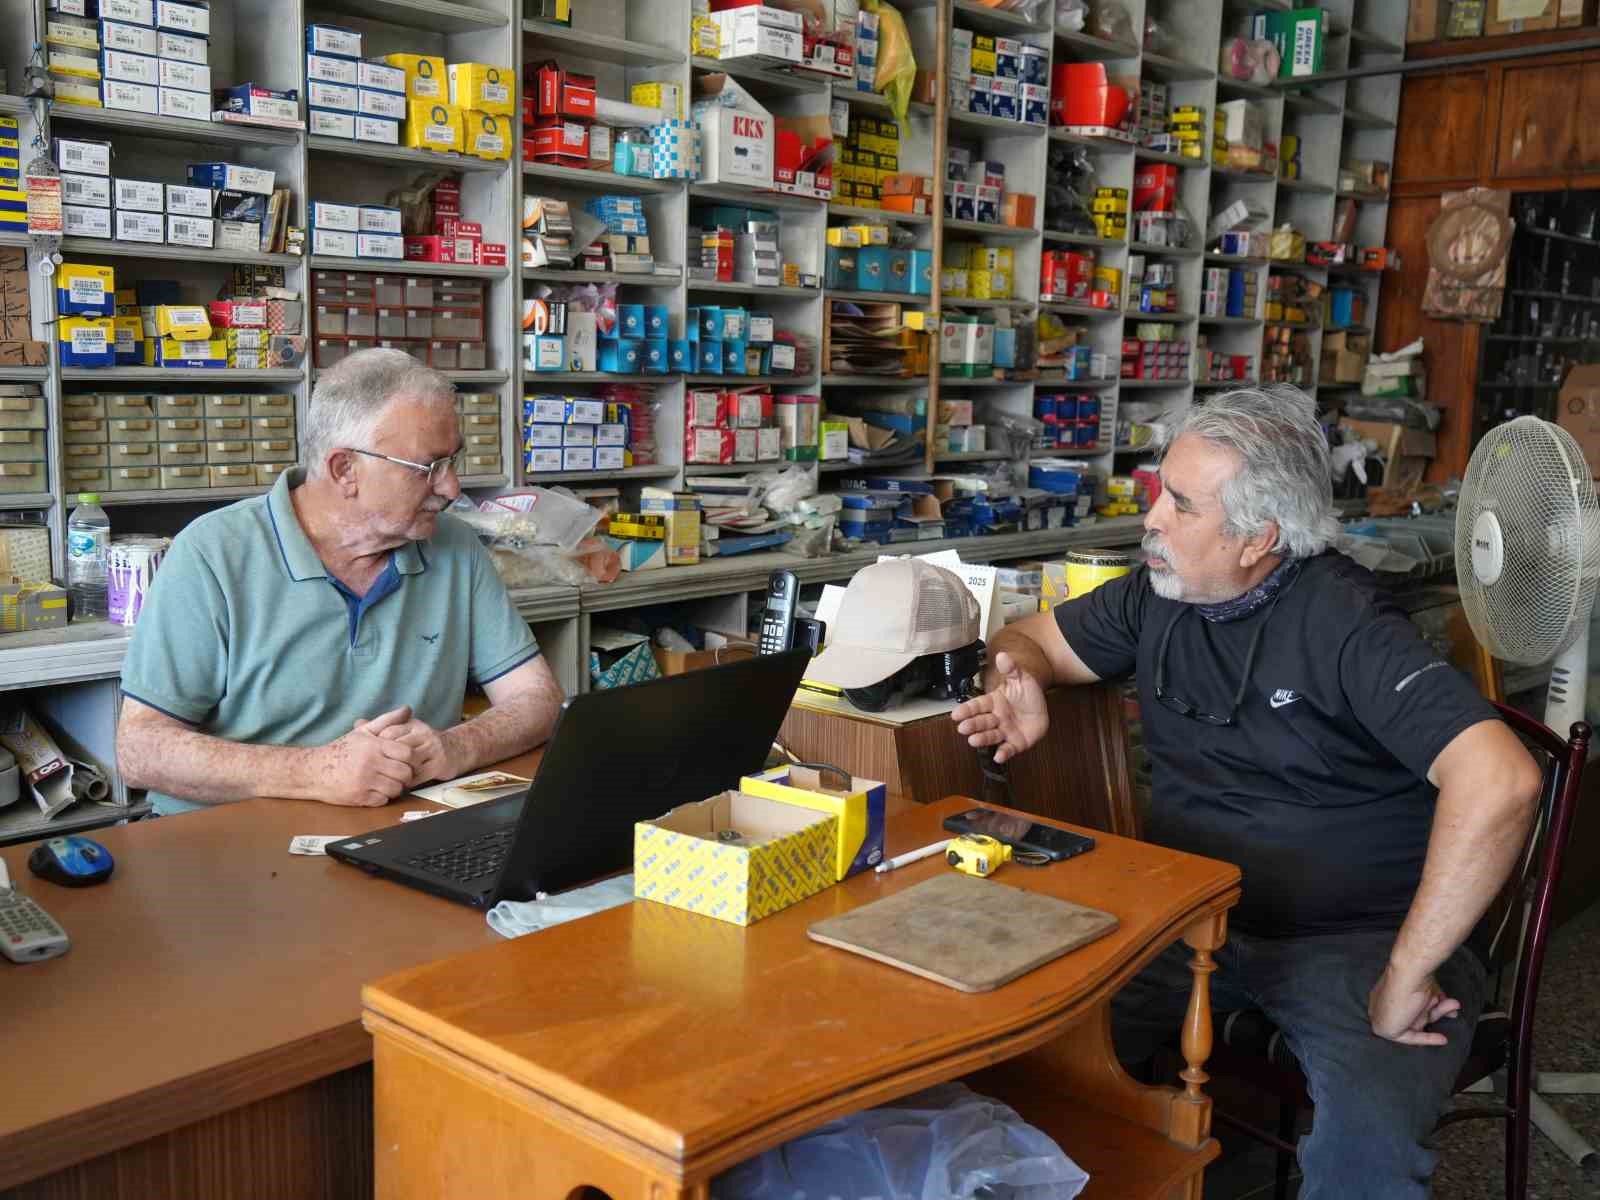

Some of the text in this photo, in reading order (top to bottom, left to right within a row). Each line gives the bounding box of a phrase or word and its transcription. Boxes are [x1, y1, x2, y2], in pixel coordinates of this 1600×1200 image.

[1295, 27, 1304, 65] FILTER
[1303, 28, 1312, 65] GREEN
[733, 116, 765, 139] KKS
[967, 577, 987, 586] 2025
[1274, 688, 1296, 701] NIKE
